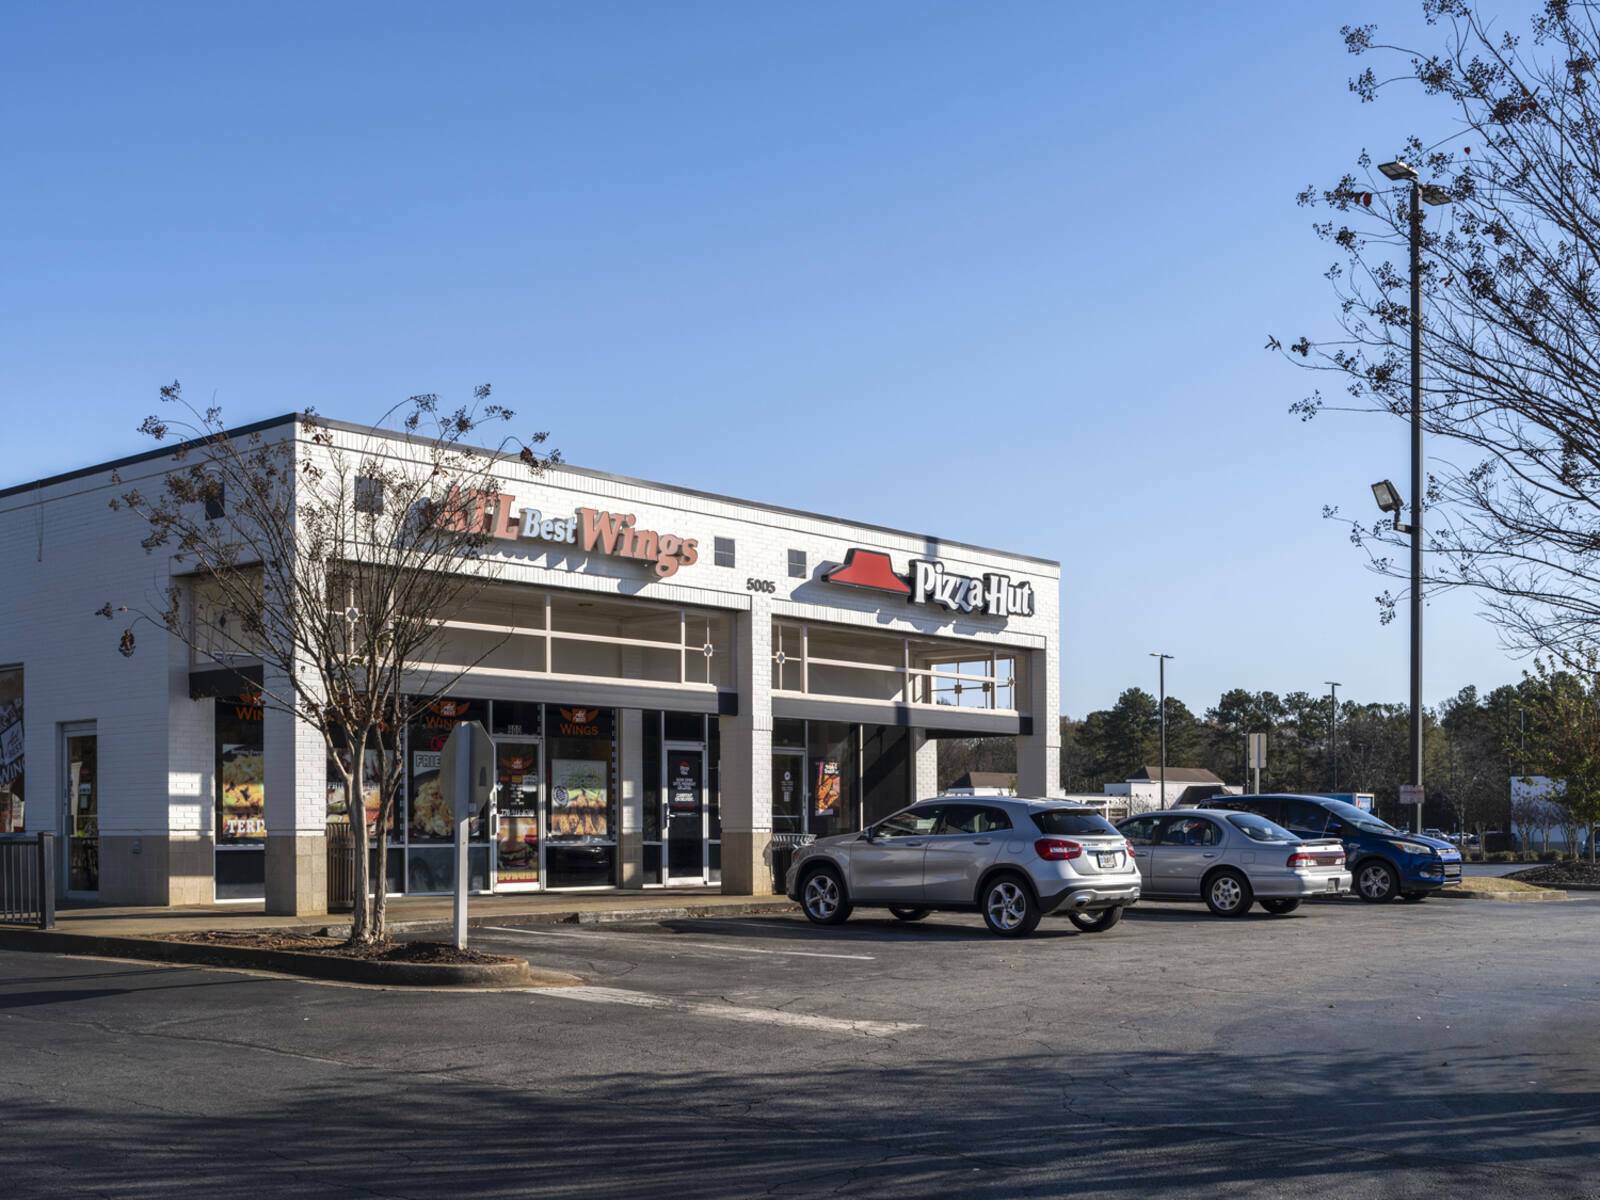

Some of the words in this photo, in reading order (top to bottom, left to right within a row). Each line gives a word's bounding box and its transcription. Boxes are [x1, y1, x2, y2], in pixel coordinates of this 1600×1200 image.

[521, 507, 577, 544] Best
[576, 507, 699, 577] Wings
[746, 577, 776, 594] 5005
[910, 560, 984, 614] Pizza
[983, 573, 1034, 617] Hut
[234, 707, 264, 721] WIN
[426, 716, 457, 729] WIN
[560, 723, 599, 736] WINGS
[415, 754, 440, 768] FRIE
[0, 756, 25, 785] WIN
